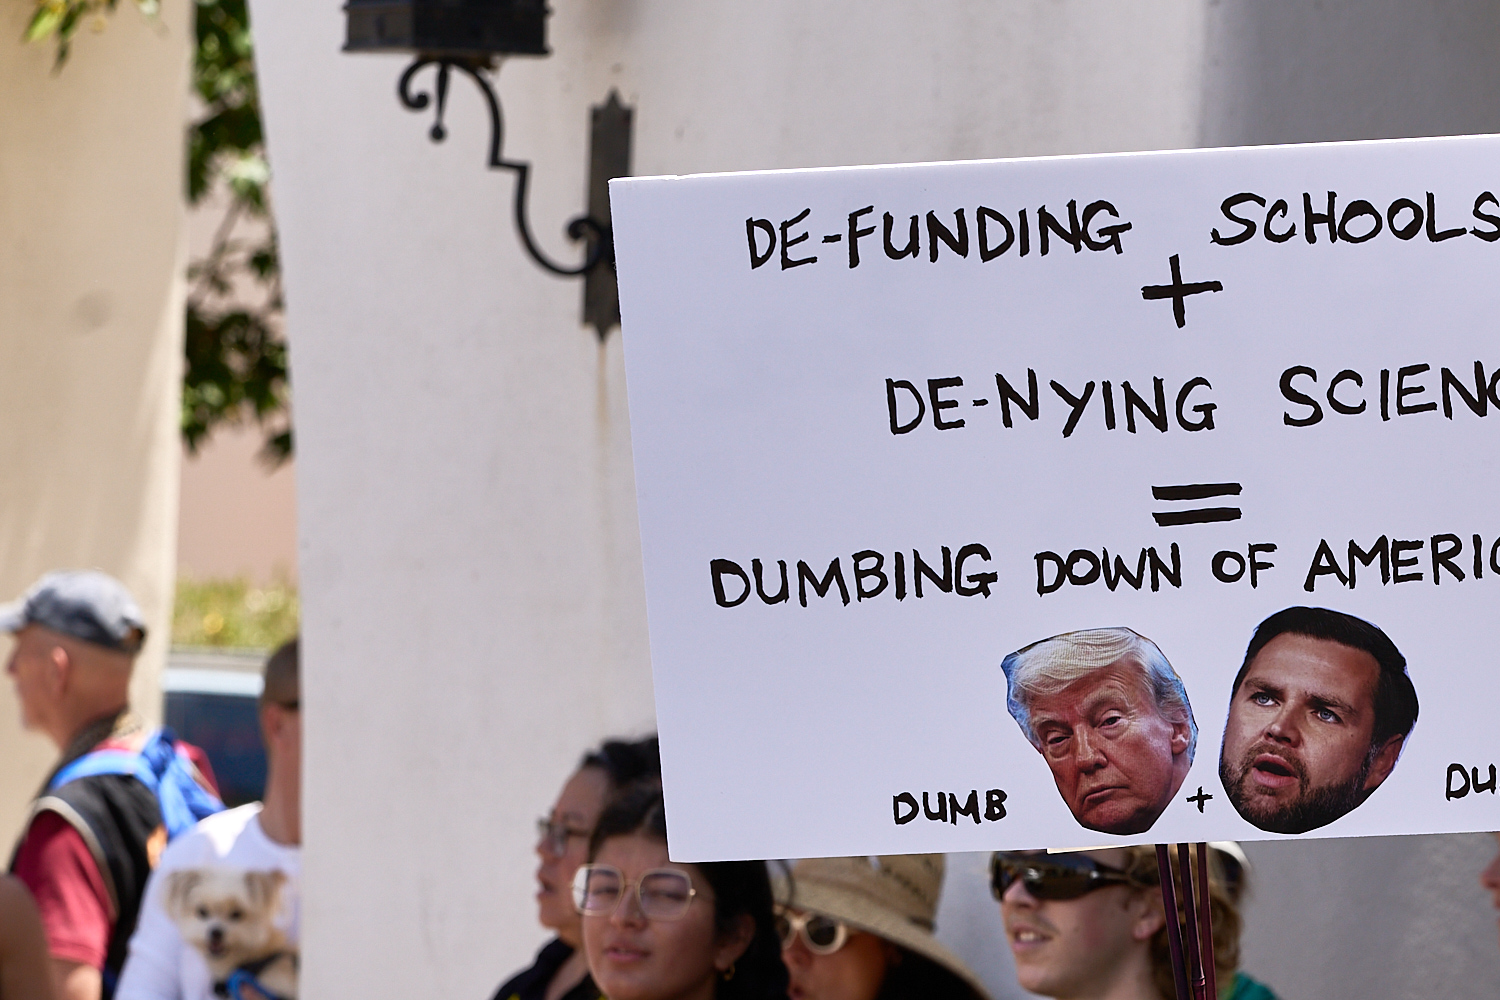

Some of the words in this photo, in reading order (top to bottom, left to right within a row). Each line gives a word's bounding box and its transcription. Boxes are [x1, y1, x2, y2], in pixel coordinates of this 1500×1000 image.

[746, 199, 1133, 271] DE-FUNDING
[885, 368, 1217, 438] DE-NYING
[709, 543, 999, 608] DUMBING
[1033, 542, 1182, 597] DOWN
[1211, 543, 1278, 589] OF
[892, 789, 1008, 826] DUMB
